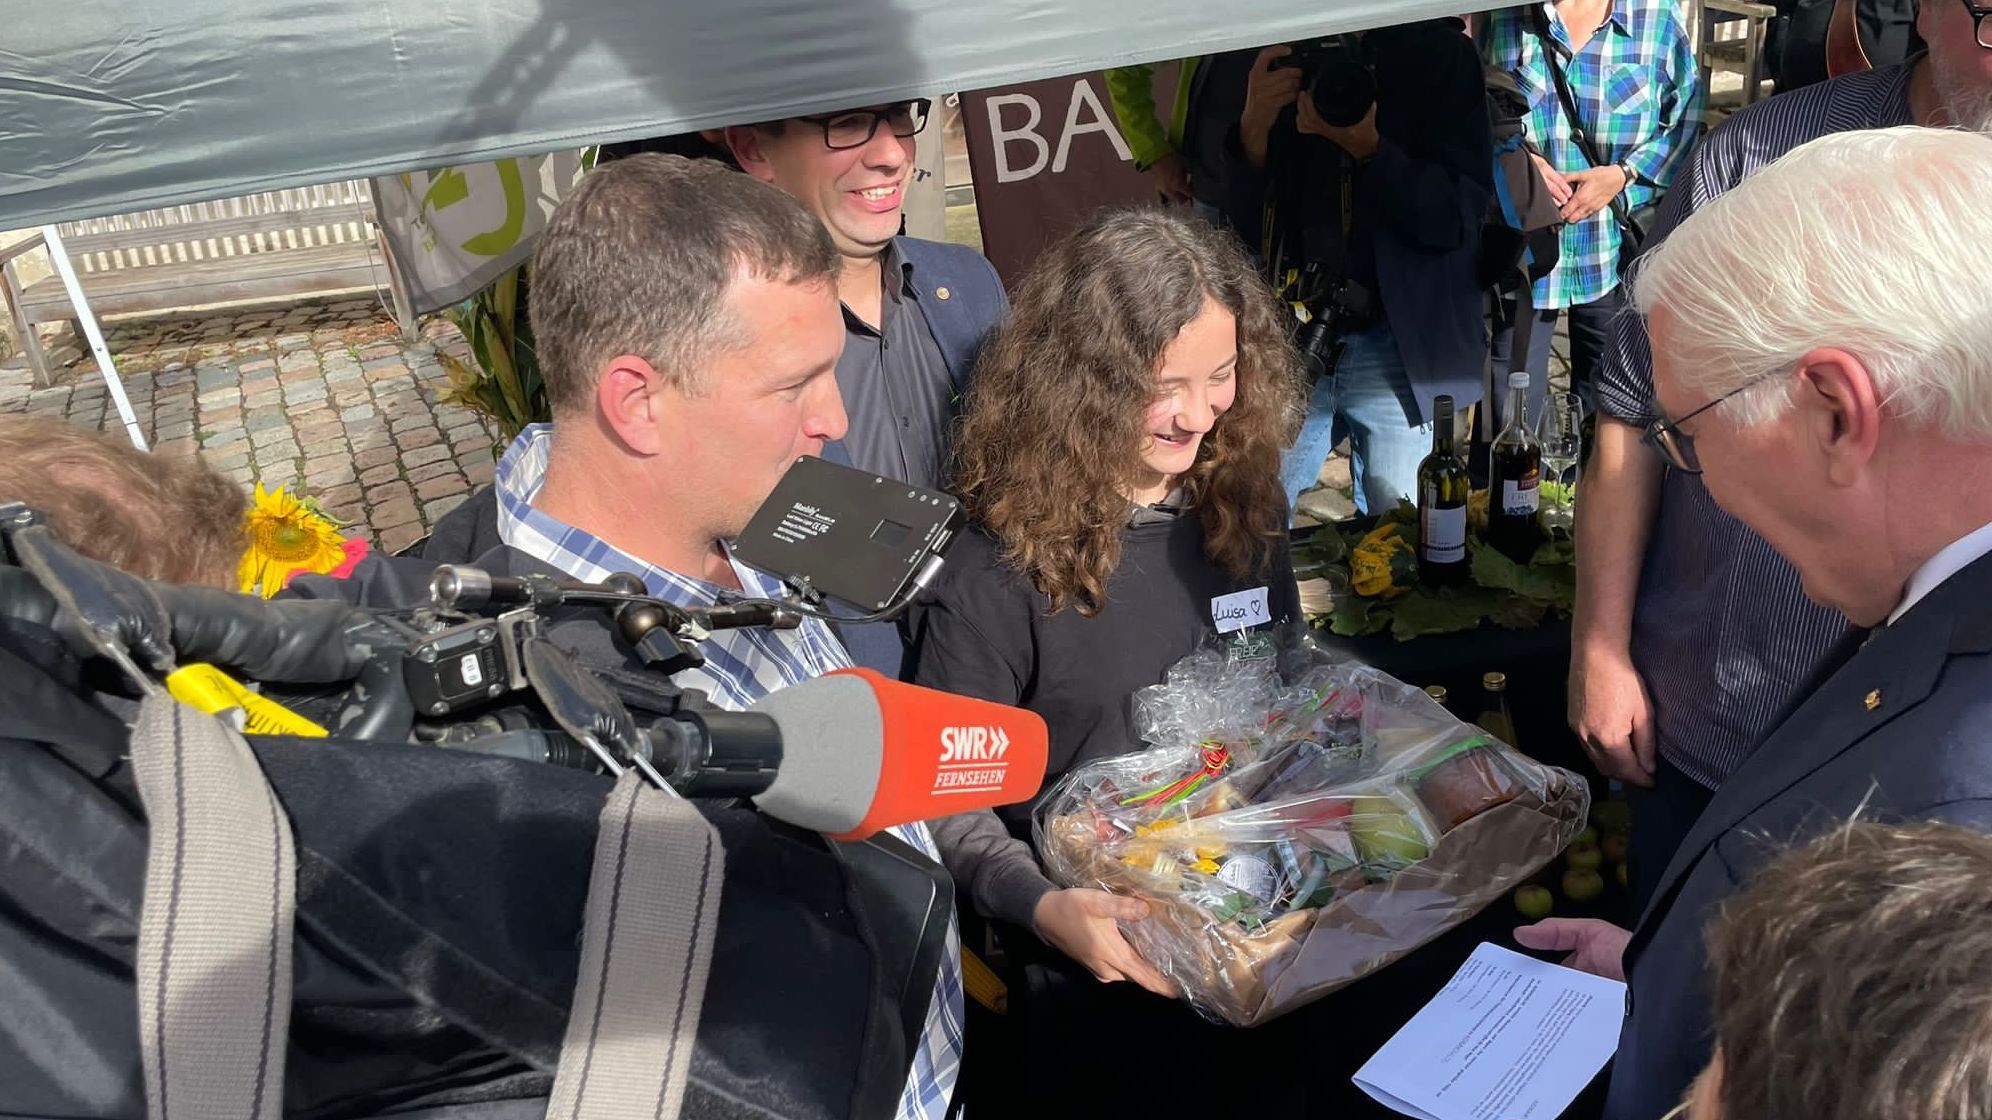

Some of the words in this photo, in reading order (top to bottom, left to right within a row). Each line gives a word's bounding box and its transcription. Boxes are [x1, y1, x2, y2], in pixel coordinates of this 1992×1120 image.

[1214, 601, 1247, 622] Luisa
[939, 726, 988, 761] SWR
[933, 769, 1006, 788] FERNSEHEN
